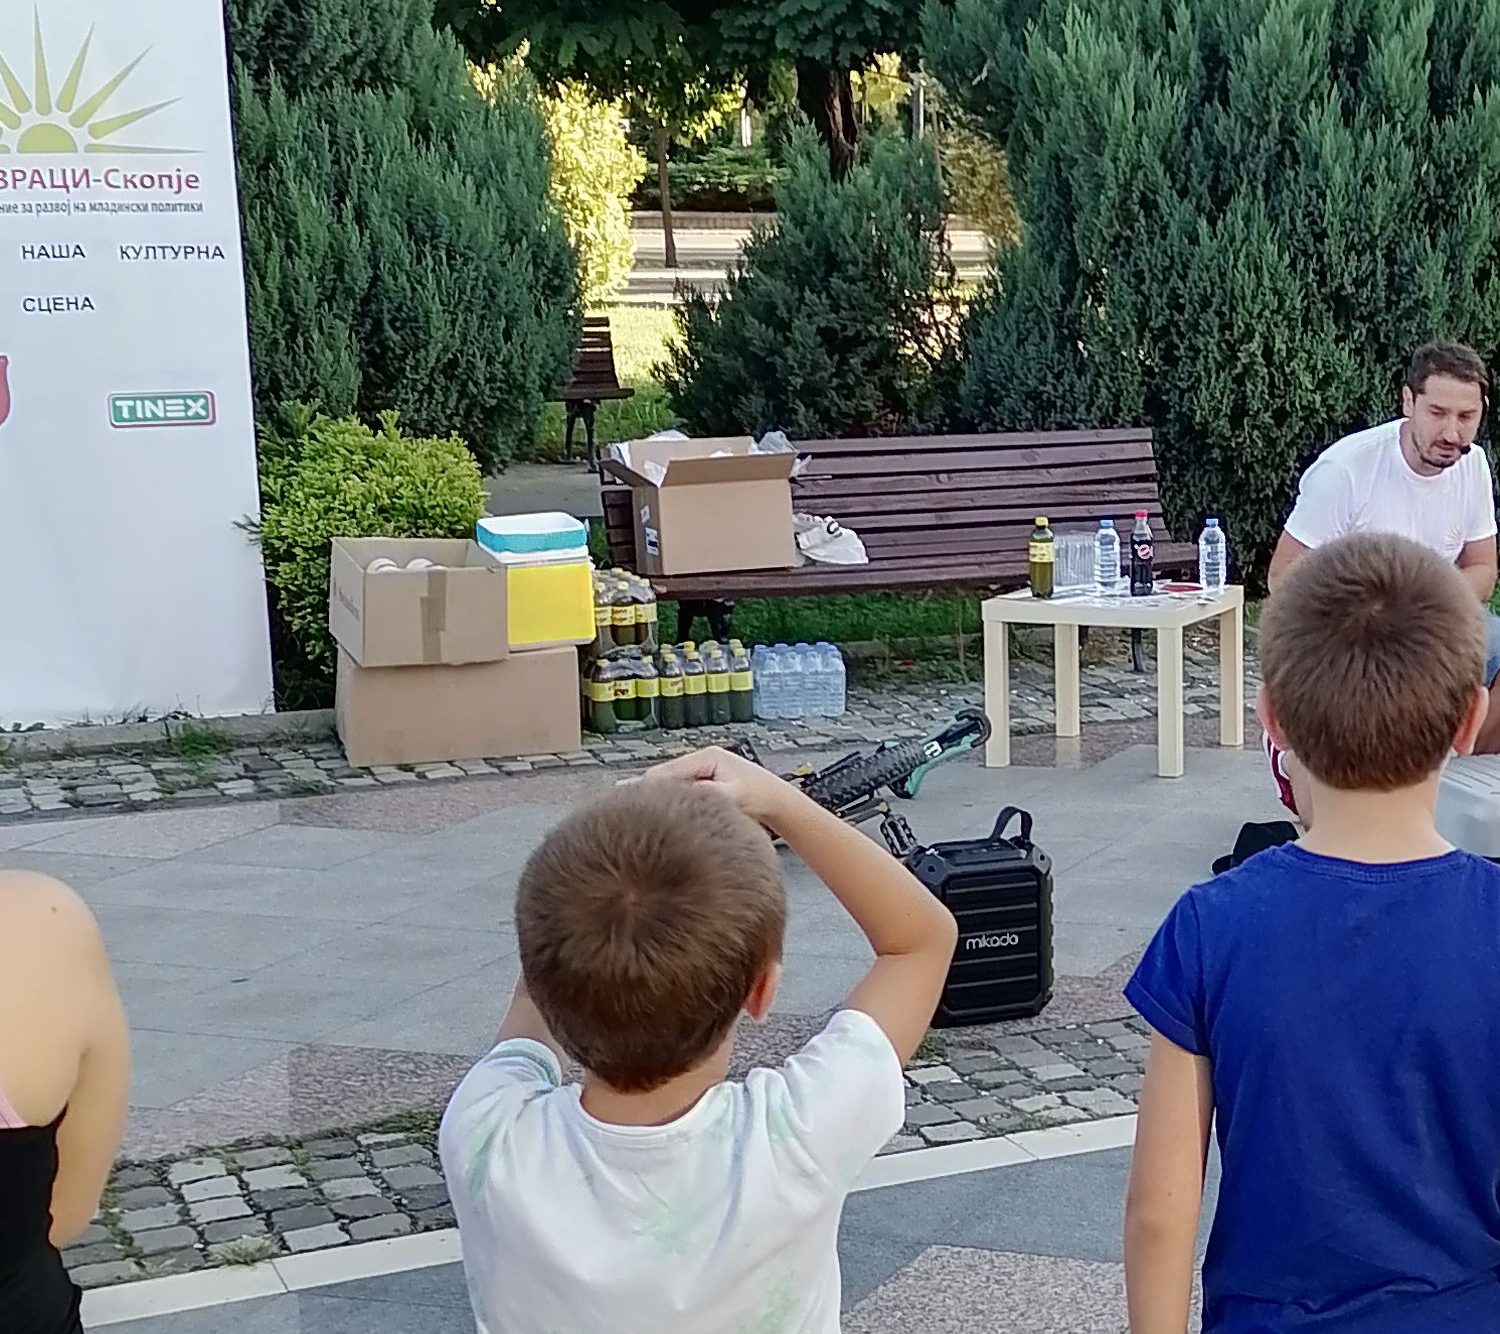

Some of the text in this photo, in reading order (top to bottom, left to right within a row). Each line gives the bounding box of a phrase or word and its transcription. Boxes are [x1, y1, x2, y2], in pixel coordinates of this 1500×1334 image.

[21, 202, 33, 213] за
[35, 198, 71, 217] развој
[73, 201, 86, 213] на
[89, 201, 149, 216] младински
[151, 201, 203, 213] политики
[21, 244, 225, 260] НАША КУЛТУРНА
[22, 296, 95, 314] СЦЕНА
[114, 397, 207, 419] TINEX
